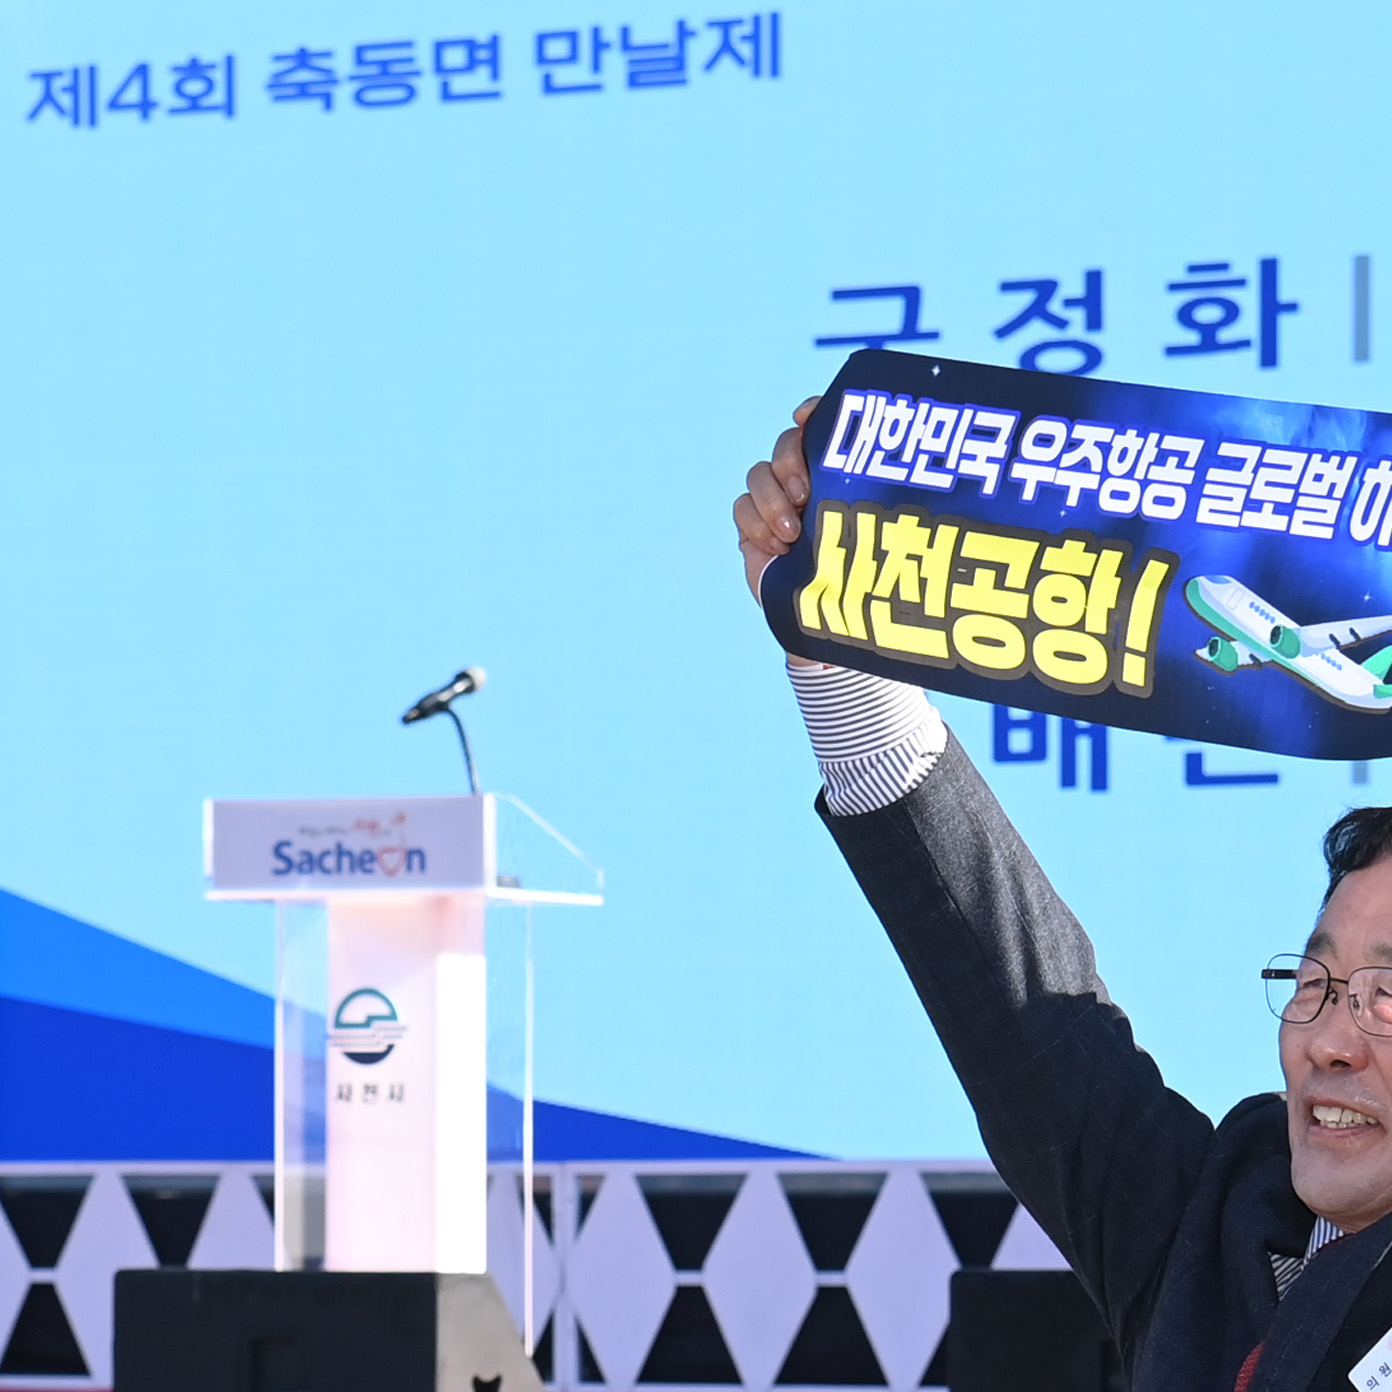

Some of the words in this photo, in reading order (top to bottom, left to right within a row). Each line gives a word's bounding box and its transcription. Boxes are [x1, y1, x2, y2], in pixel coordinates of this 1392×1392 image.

[27, 55, 239, 129] 제4회
[265, 33, 504, 113] 축동면
[534, 11, 782, 97] 만날제
[821, 391, 1016, 494] 대한민국
[1016, 418, 1204, 522] 우주항공
[1198, 441, 1354, 540] 글로벌
[798, 508, 1172, 690] 사천공항!
[1366, 1362, 1392, 1391] 의원
